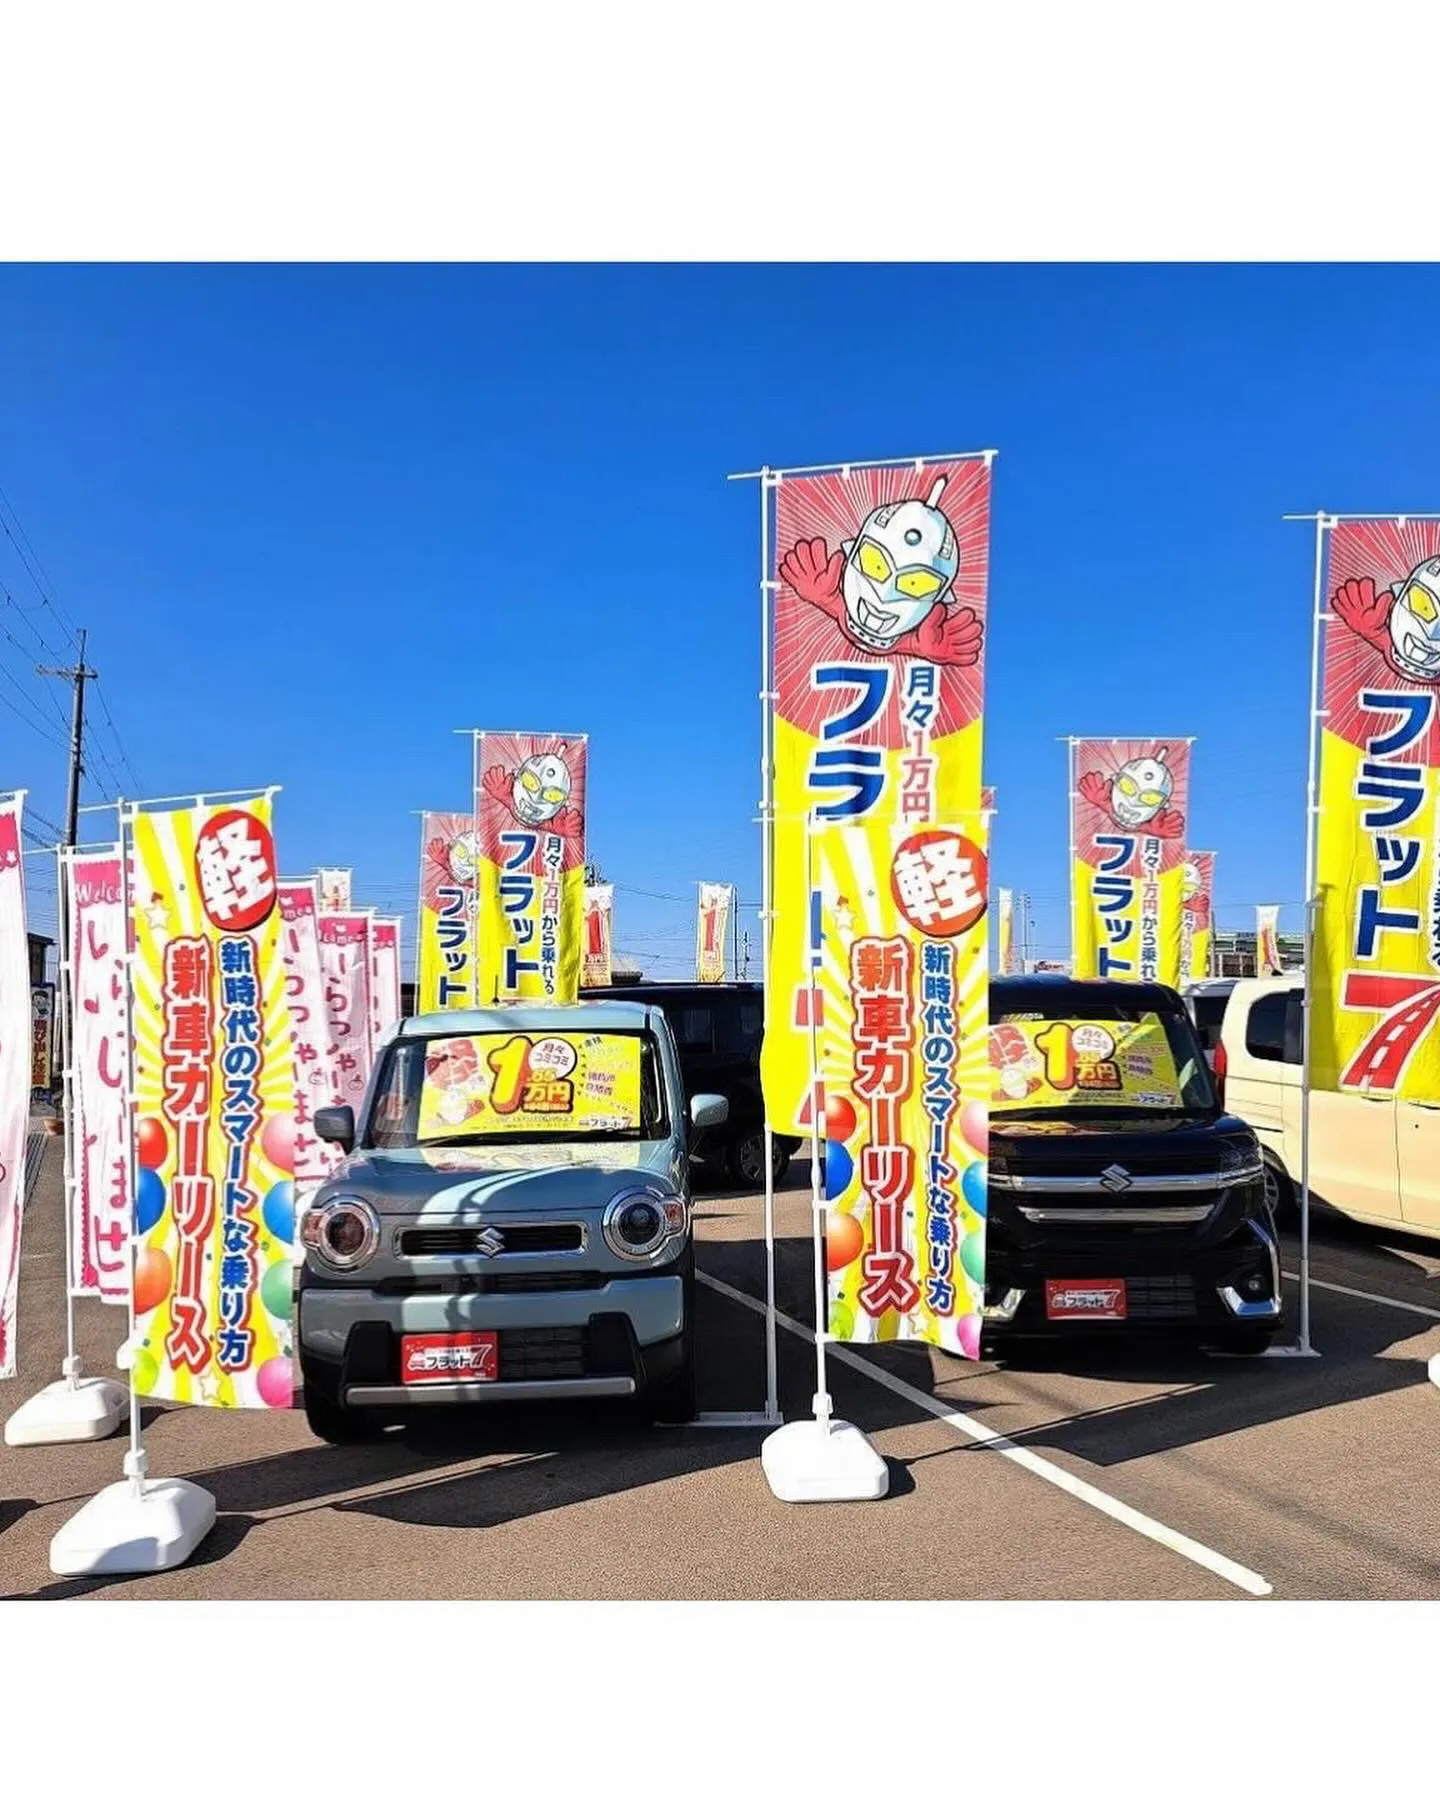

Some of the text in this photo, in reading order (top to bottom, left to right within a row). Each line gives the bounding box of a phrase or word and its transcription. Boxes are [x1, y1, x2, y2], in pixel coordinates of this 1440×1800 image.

[808, 667, 889, 819] フラ
[902, 667, 936, 822] 月々1万円
[197, 818, 271, 921] 軽
[500, 834, 540, 989] フラット
[893, 839, 983, 926] 軽
[1093, 836, 1134, 977] フラット
[1141, 838, 1160, 980] 月々1万円から乗れ
[436, 888, 468, 1006] フラット
[165, 942, 214, 1370] 新車カーリース
[219, 939, 259, 1366] 新時代のスマートな乗り方
[854, 942, 915, 1311] 新車カーリース
[922, 944, 957, 1309] 新時代のスマートな乗り方
